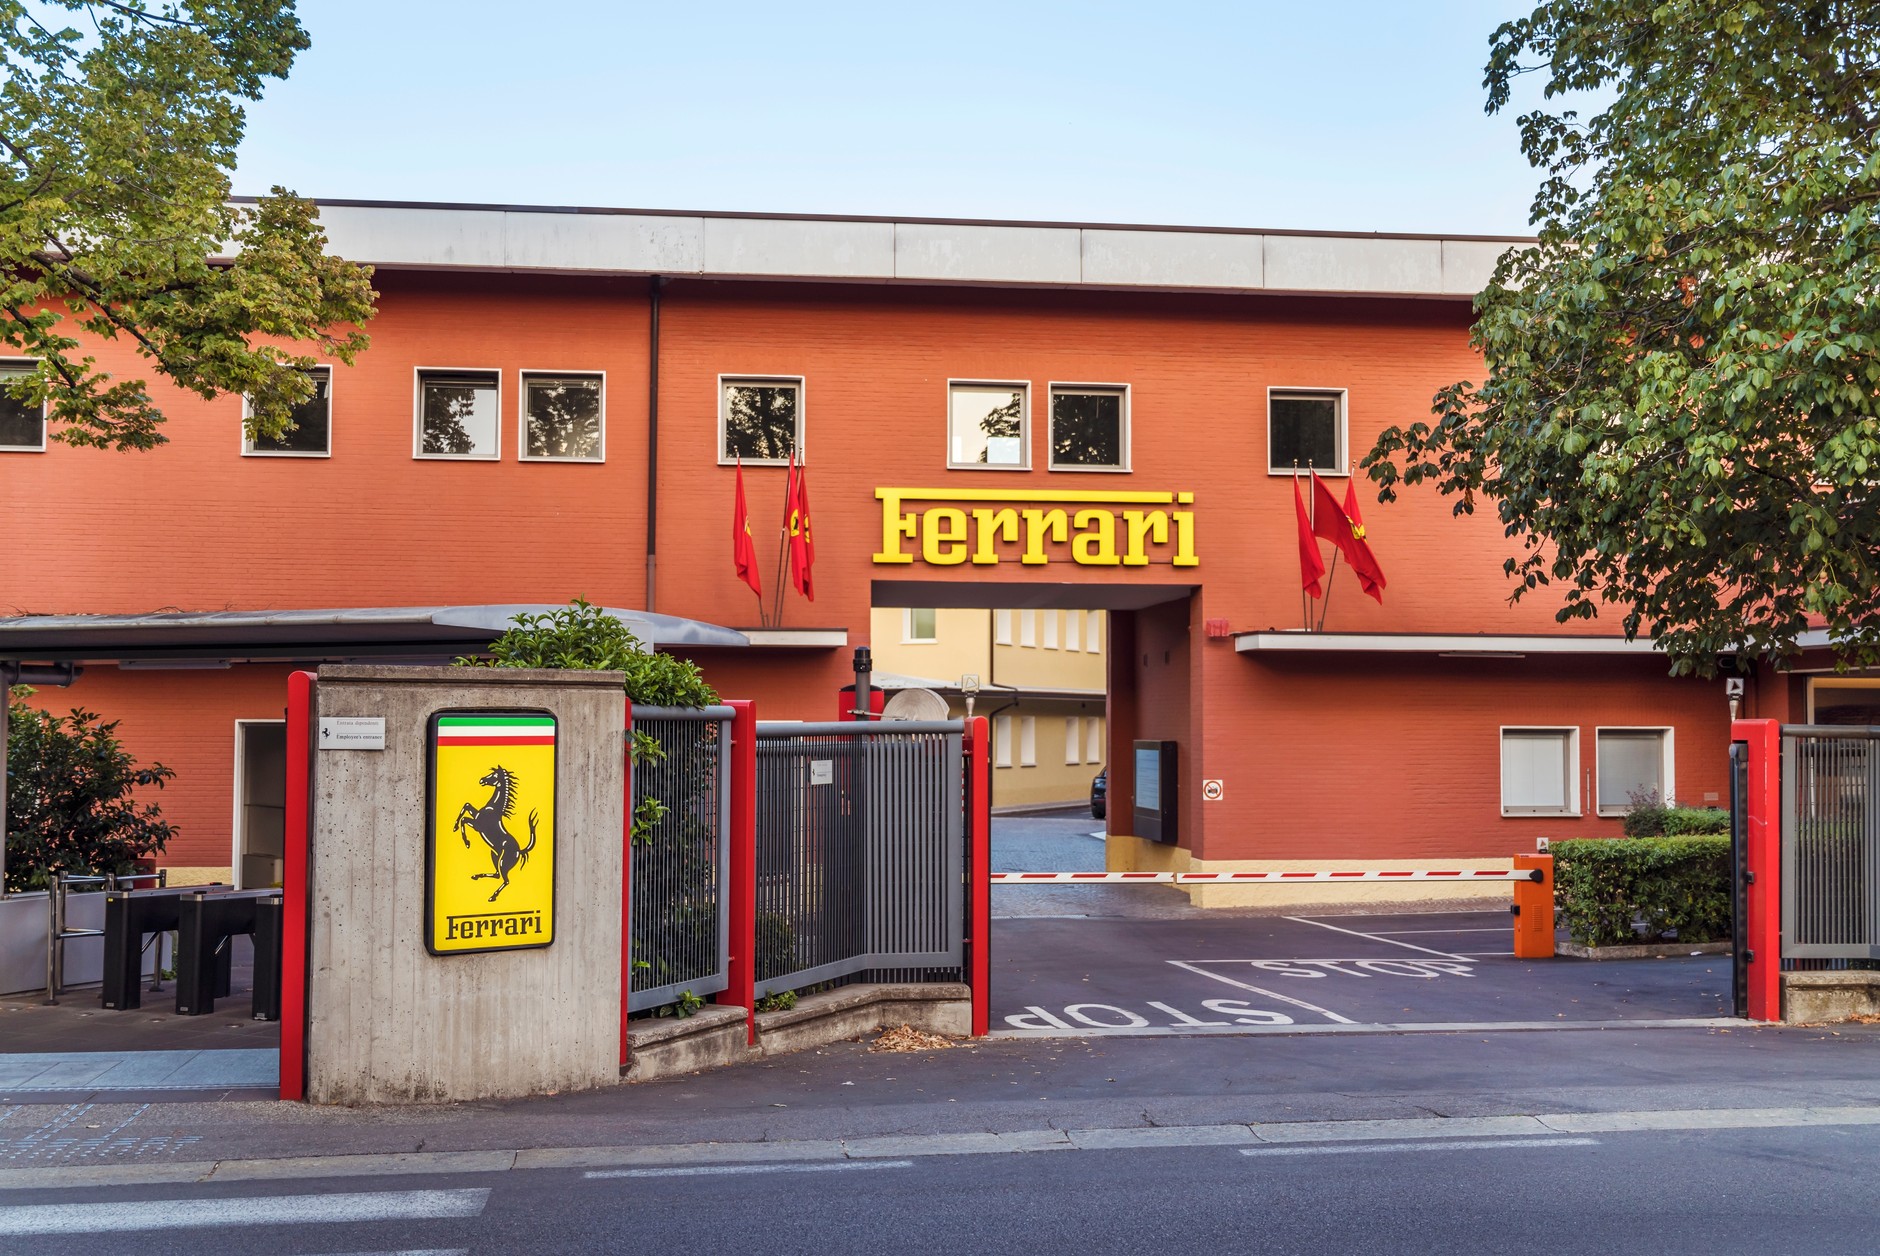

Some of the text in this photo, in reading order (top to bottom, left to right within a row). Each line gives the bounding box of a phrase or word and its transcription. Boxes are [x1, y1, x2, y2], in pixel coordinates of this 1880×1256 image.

[873, 487, 1199, 565] Ferrari
[445, 910, 542, 940] Ferrari
[1251, 961, 1476, 978] STOP
[1003, 999, 1295, 1029] STOP
